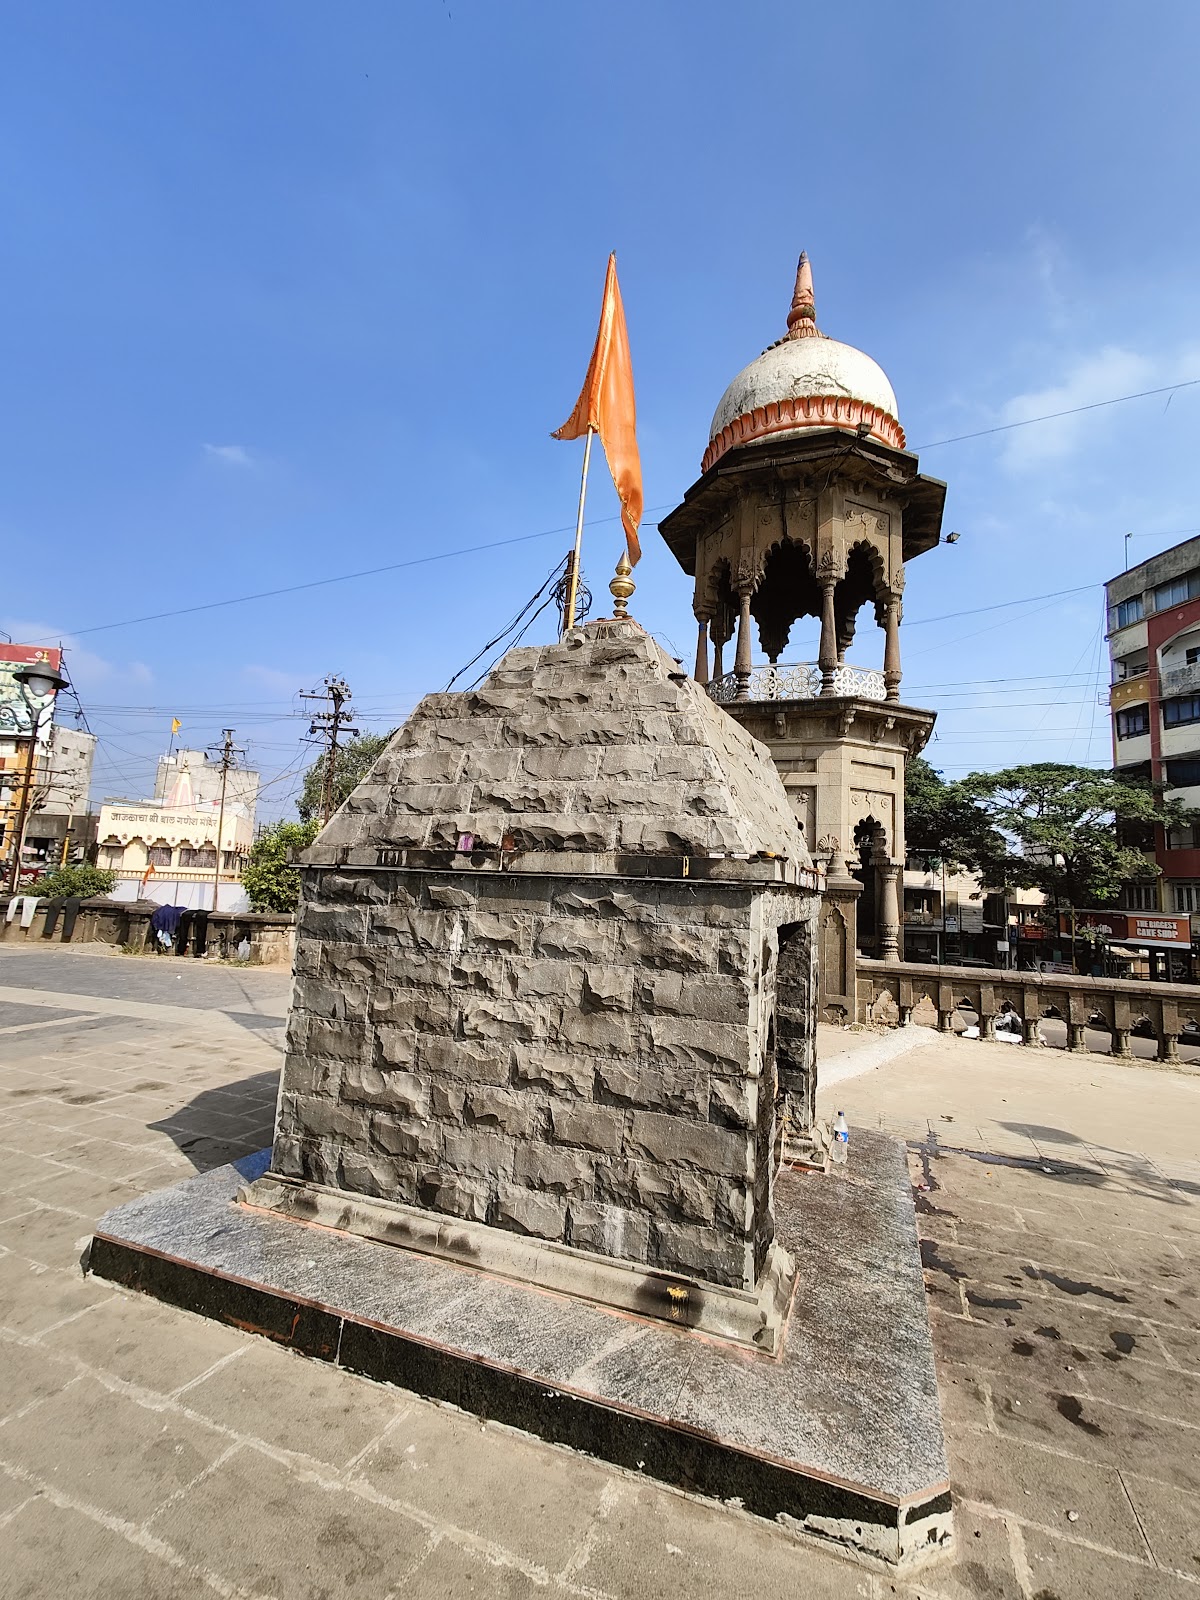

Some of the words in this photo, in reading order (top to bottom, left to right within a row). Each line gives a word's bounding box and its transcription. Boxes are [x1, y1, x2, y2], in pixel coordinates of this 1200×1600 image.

[149, 813, 159, 823] श्री
[176, 815, 199, 826] गणेश
[200, 816, 217, 828] मंदिर
[1136, 920, 1149, 928] THE
[1149, 920, 1178, 930] BIGGEST
[1136, 927, 1157, 938] CAKE
[1157, 929, 1179, 939] SHOP
